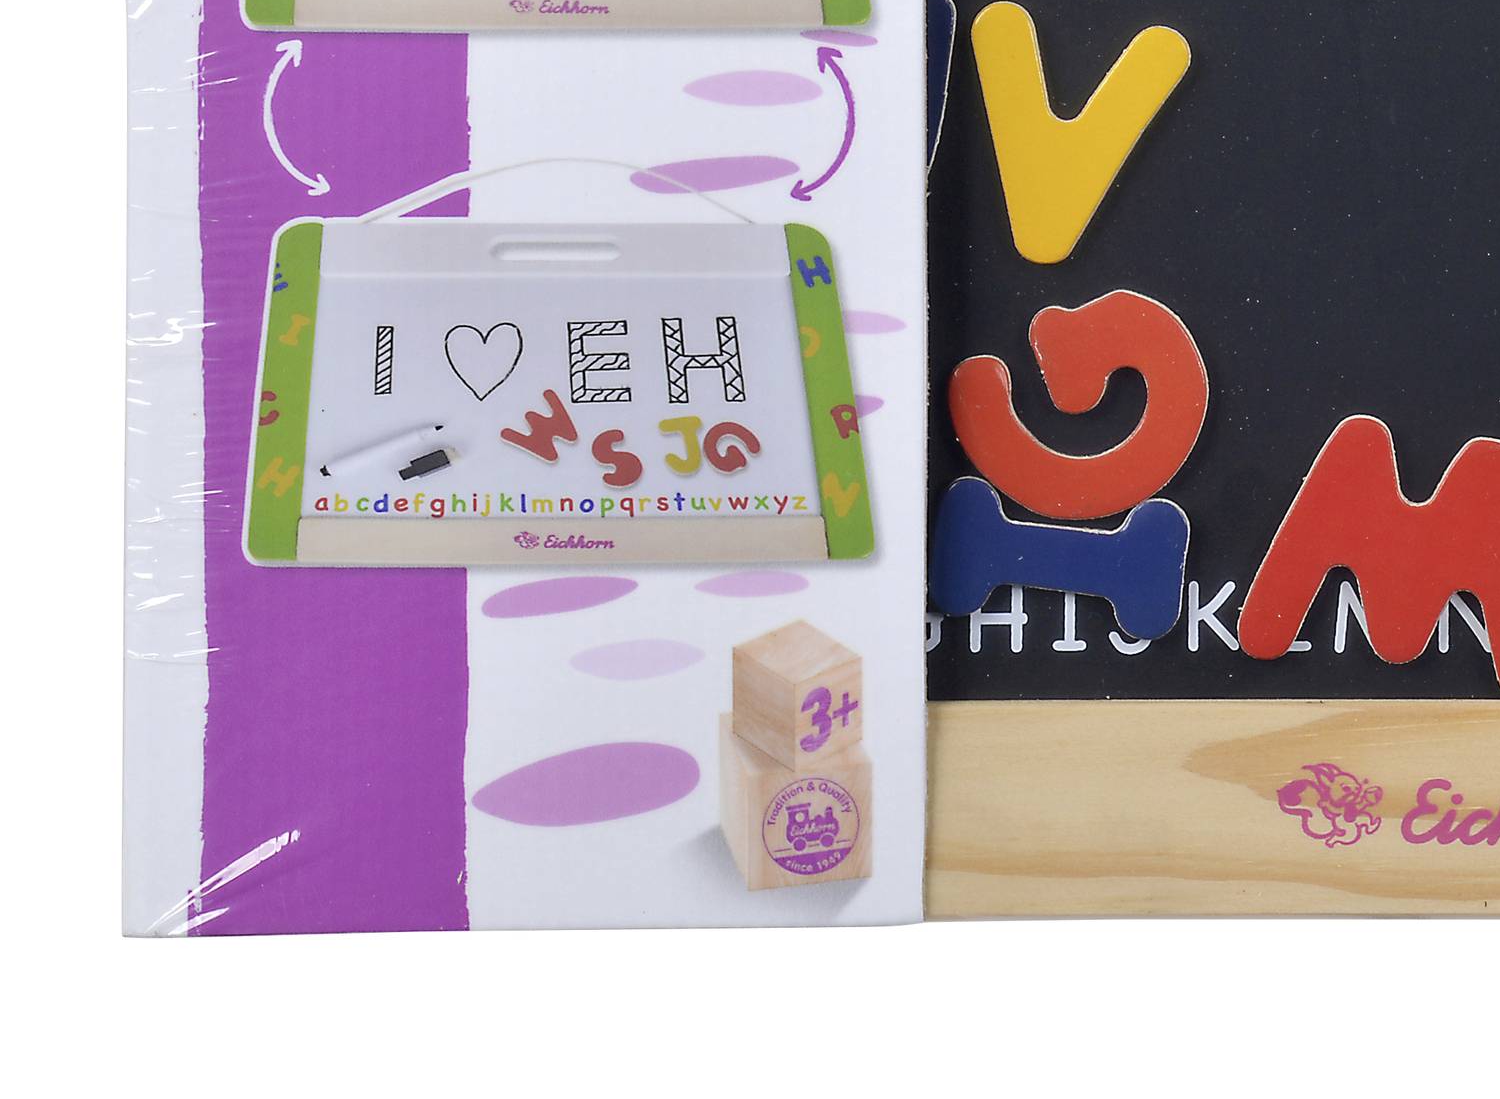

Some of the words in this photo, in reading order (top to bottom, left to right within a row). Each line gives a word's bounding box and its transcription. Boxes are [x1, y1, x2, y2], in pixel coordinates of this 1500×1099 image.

[538, 0, 610, 16] Eichhorn
[971, 1, 1190, 264] V
[797, 255, 832, 288] H
[592, 429, 642, 487] S
[659, 416, 702, 474] J
[703, 421, 760, 473] G
[543, 534, 615, 550] Eichhorn
[800, 687, 858, 751] 3+
[767, 786, 804, 825] Tradition
[807, 781, 815, 791] &
[819, 783, 852, 812] Quality
[785, 859, 814, 873] since
[816, 851, 842, 870] 1949
